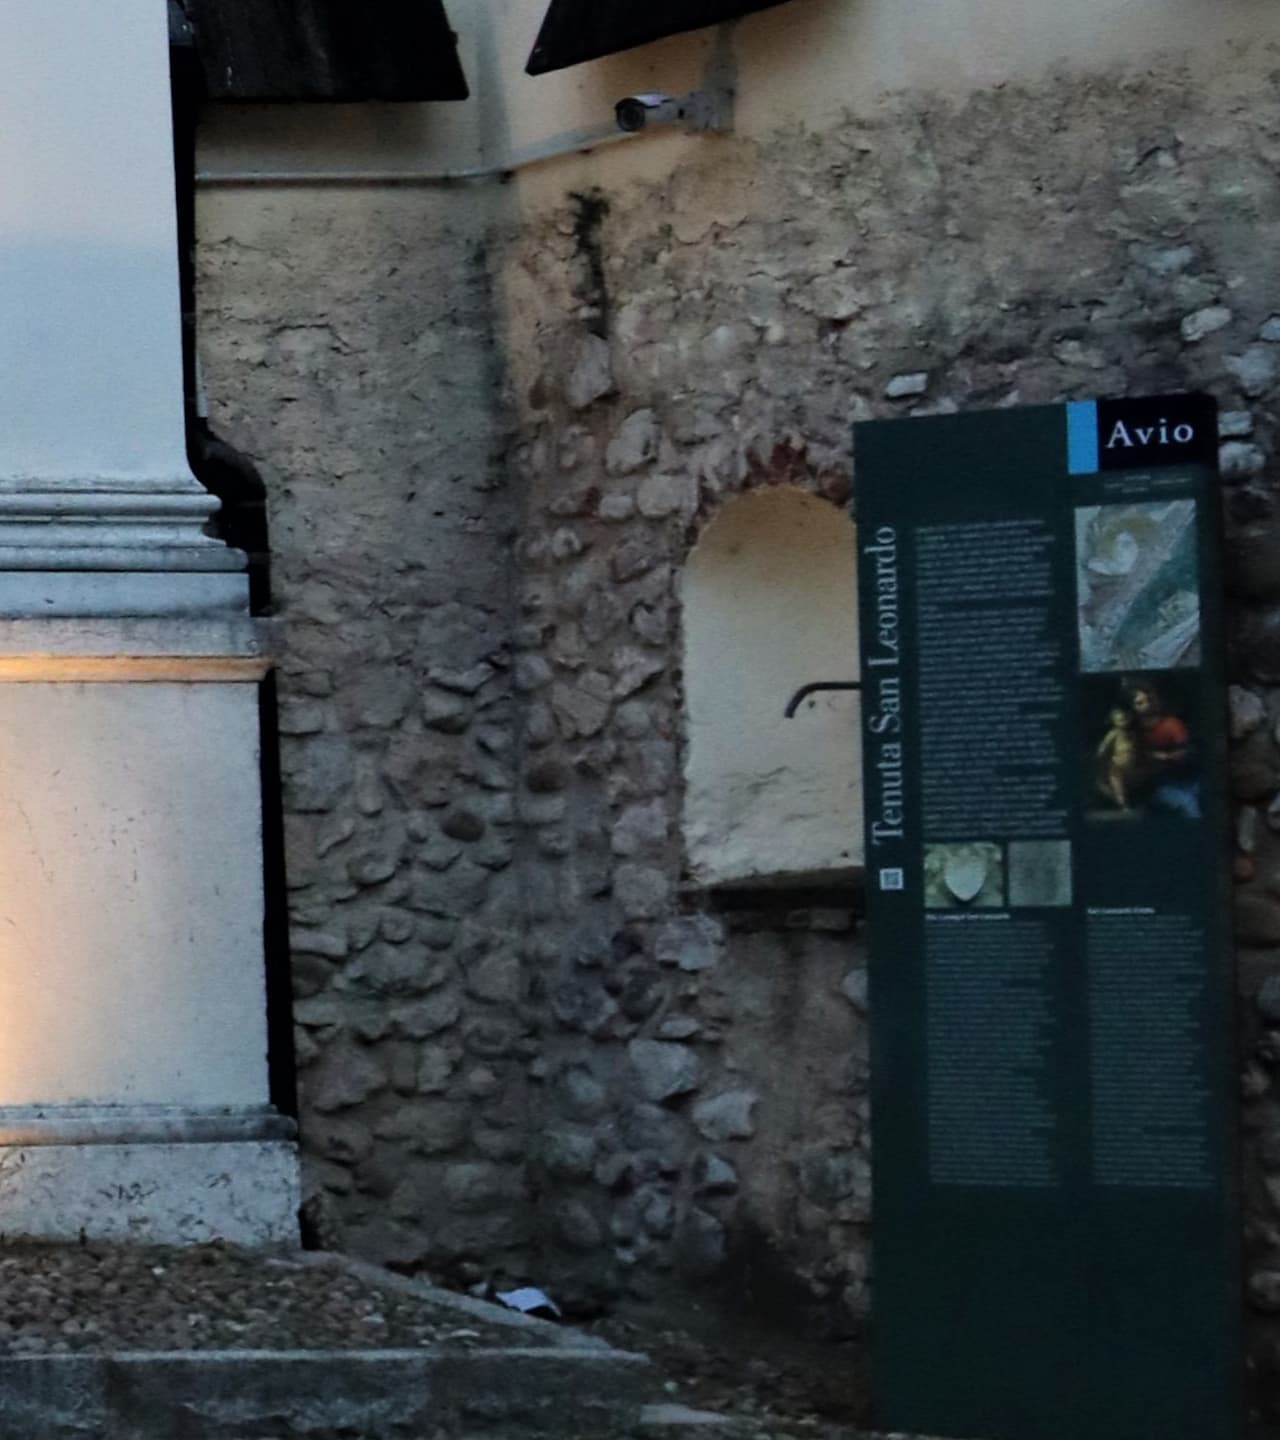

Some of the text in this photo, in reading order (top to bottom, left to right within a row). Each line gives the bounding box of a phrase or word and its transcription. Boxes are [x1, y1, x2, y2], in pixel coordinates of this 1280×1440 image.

[1104, 417, 1195, 449] Avio
[864, 526, 905, 846] Tenuta San Leonardo
